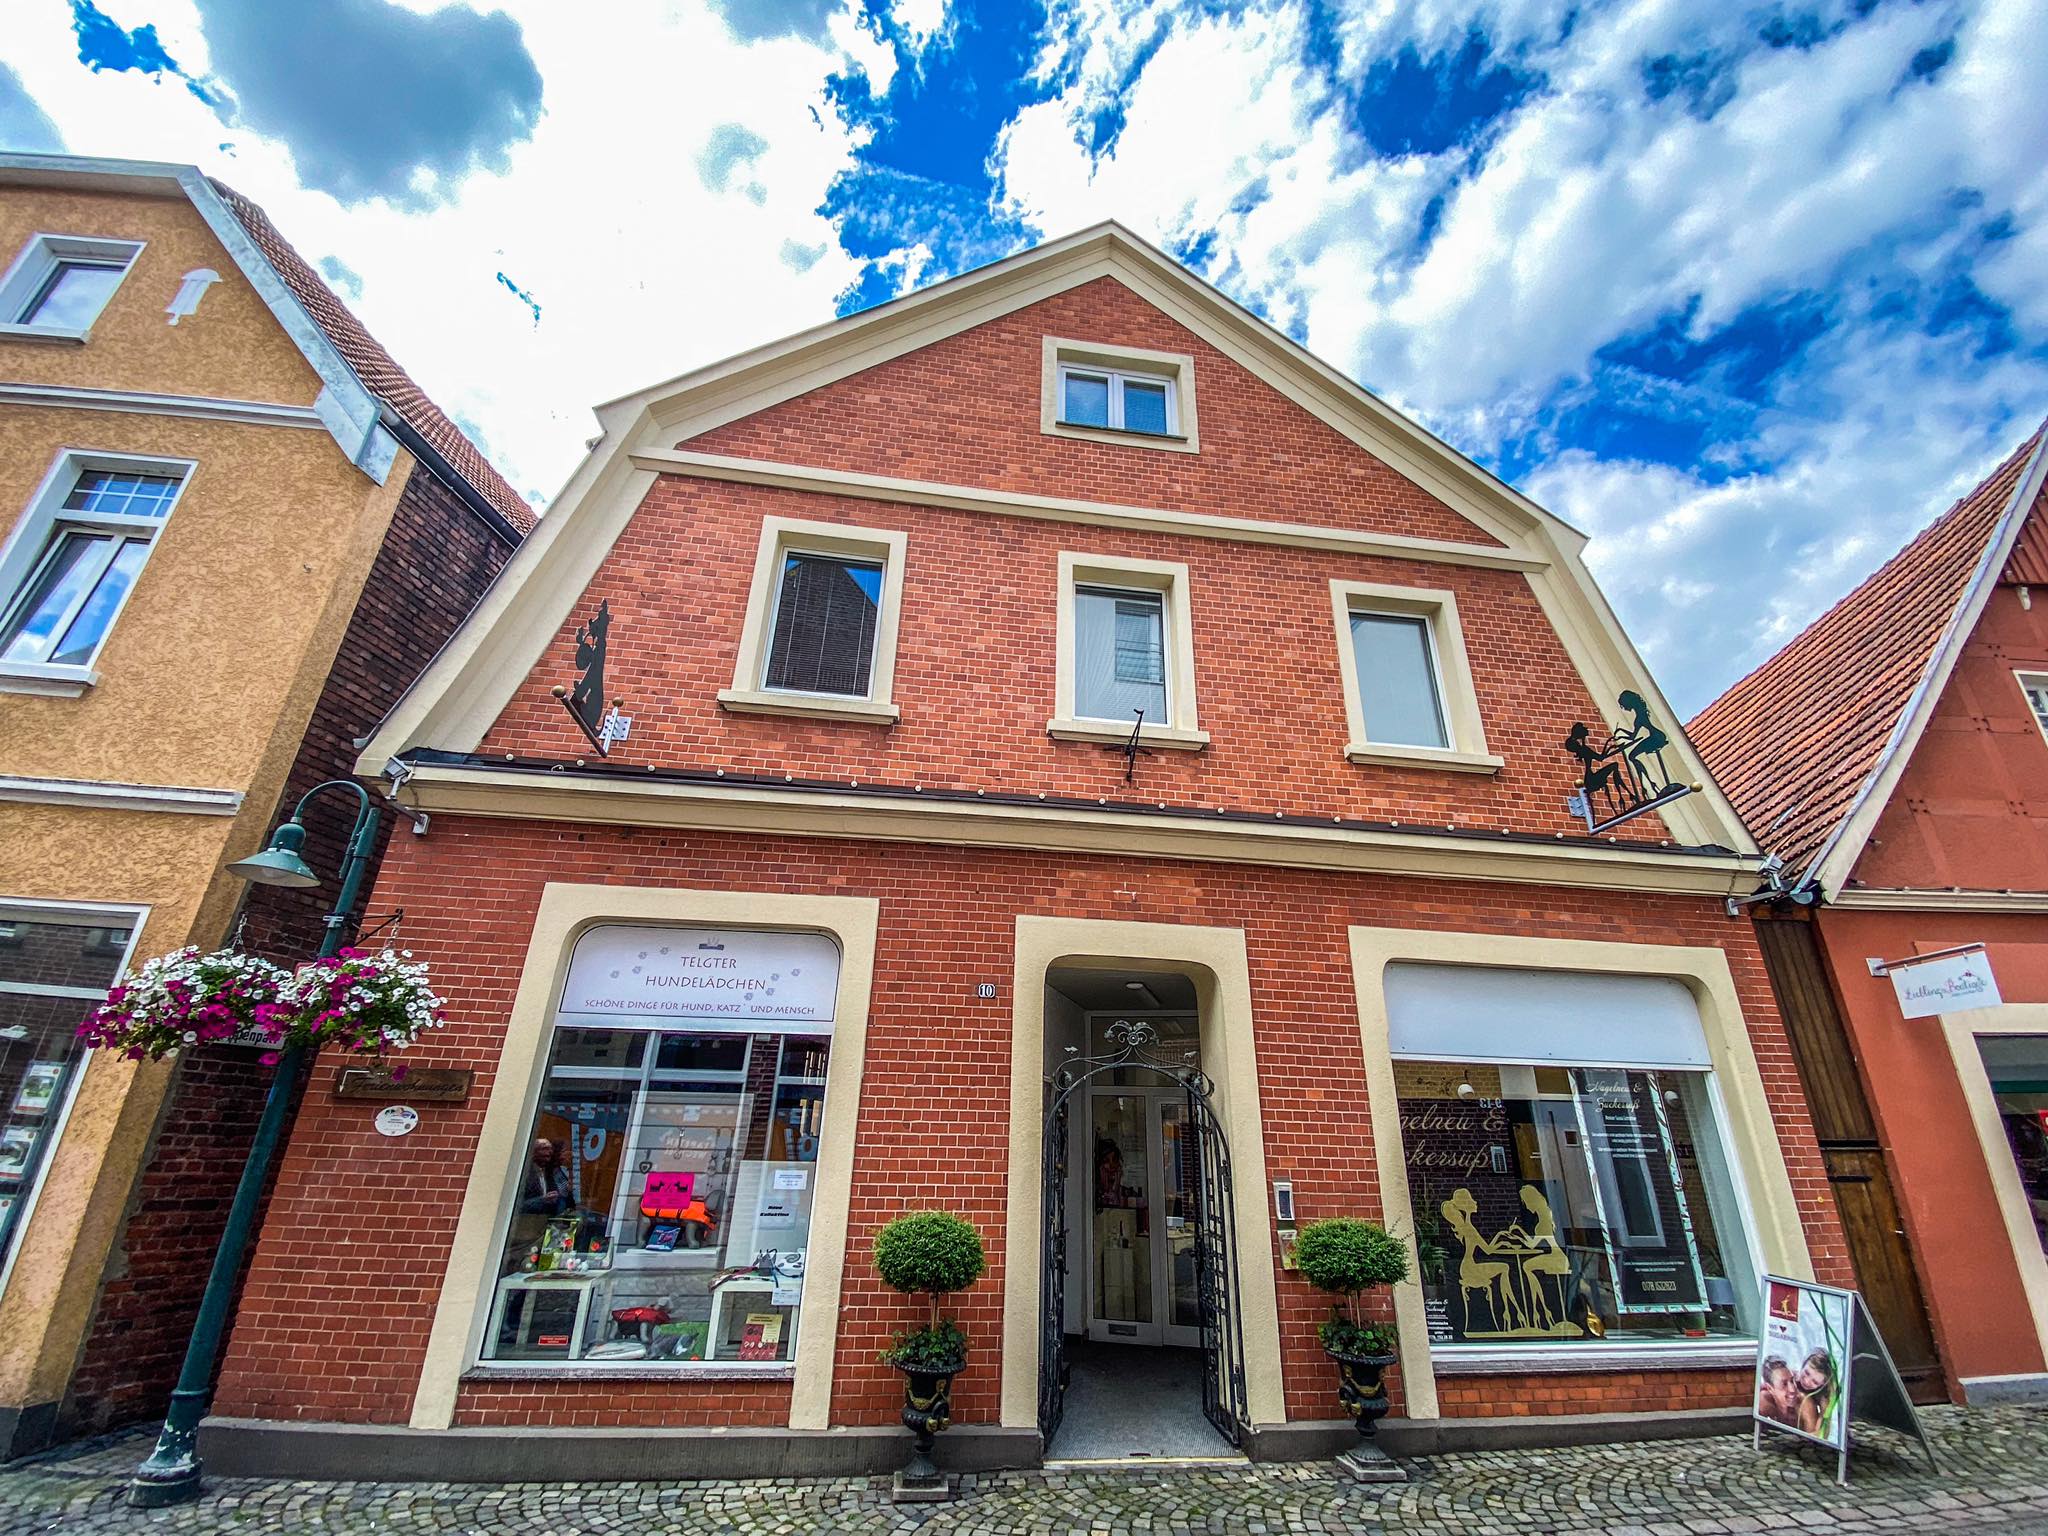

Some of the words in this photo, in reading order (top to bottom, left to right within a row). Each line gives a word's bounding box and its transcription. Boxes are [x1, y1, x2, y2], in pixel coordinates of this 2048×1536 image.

[681, 956, 737, 969] TELGTER
[645, 975, 766, 991] HUNDELÄDCHEN
[980, 985, 993, 997] 10
[585, 999, 625, 1009] SCHÖNE
[627, 1001, 658, 1010] DINGE
[660, 1001, 679, 1011] FÜR
[750, 1005, 773, 1014] UND
[775, 1006, 815, 1015] MENSCH
[1483, 1107, 1510, 1132] &
[1405, 1139, 1495, 1178] kersüß
